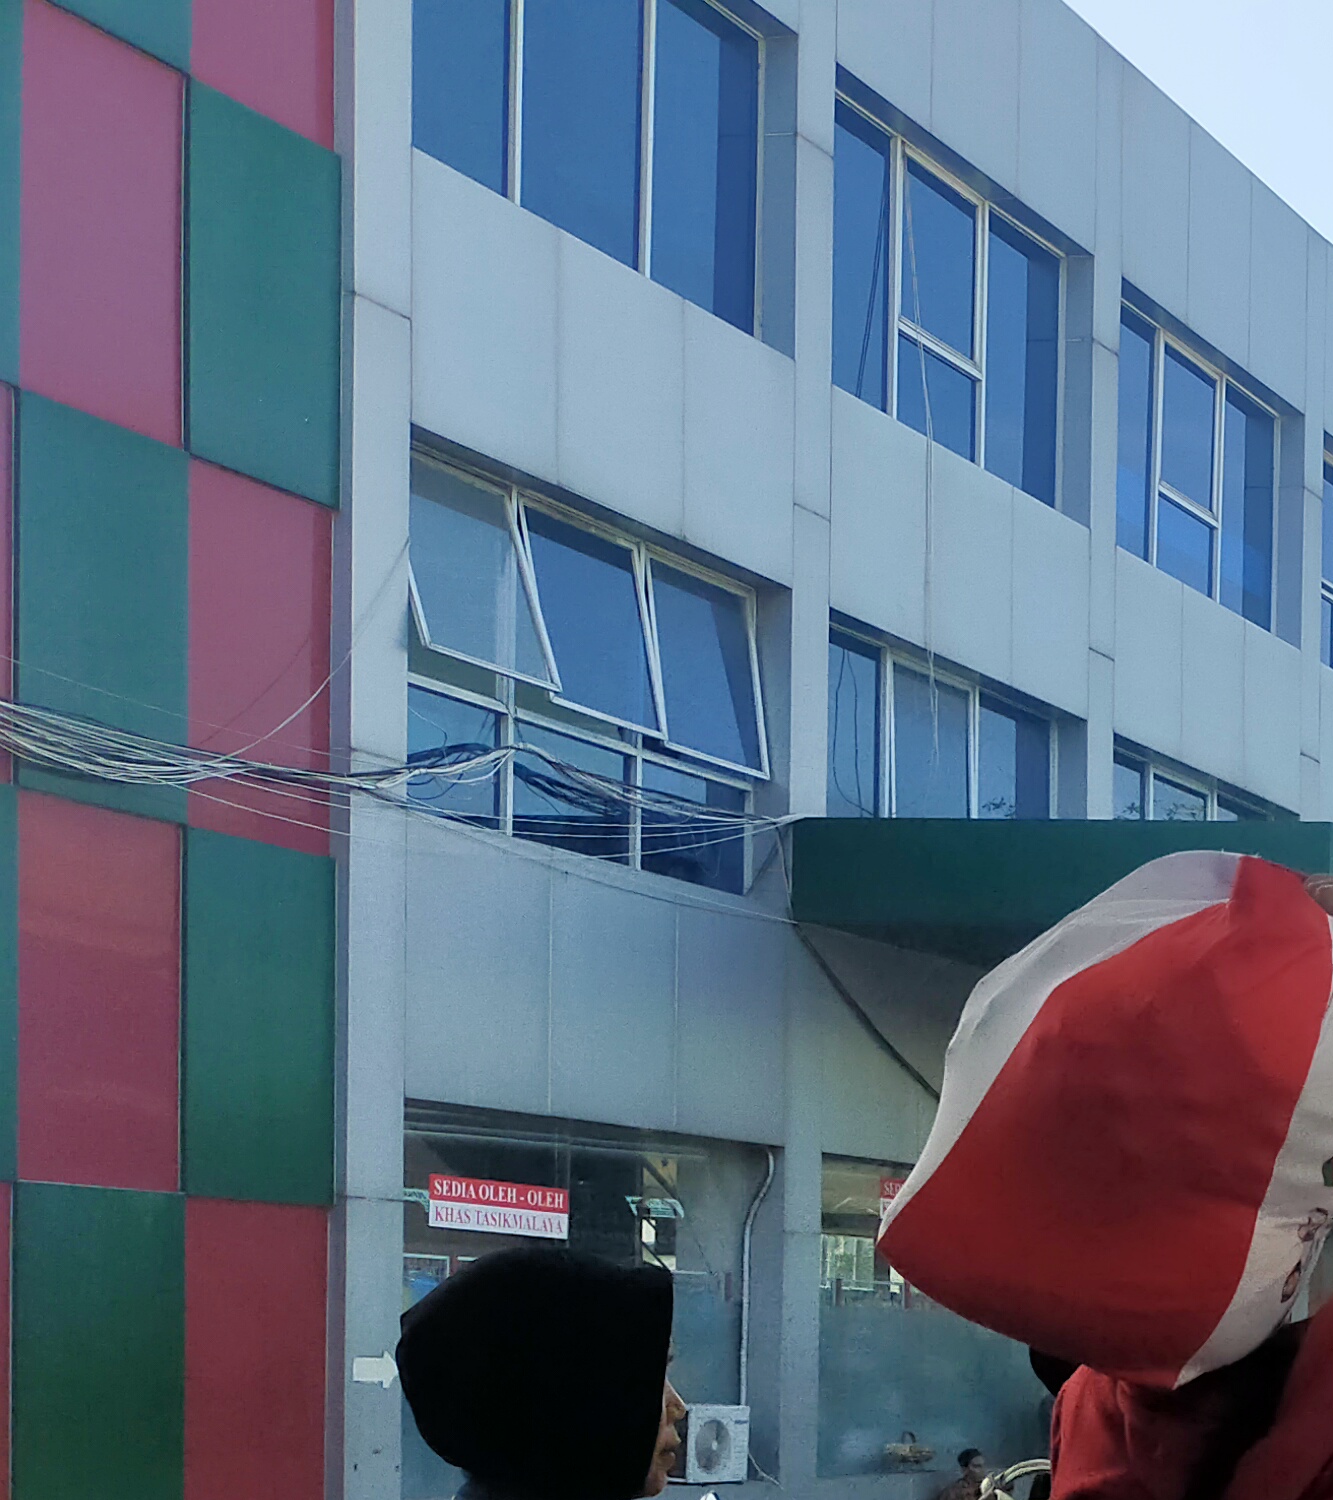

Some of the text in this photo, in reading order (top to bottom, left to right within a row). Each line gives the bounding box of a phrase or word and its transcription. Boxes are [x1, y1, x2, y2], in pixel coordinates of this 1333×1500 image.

[433, 1179, 477, 1199] SEDIA
[478, 1184, 517, 1203] OLEH
[527, 1189, 564, 1209] OLEH
[434, 1205, 564, 1235] KHAS TASIKMALAYA
